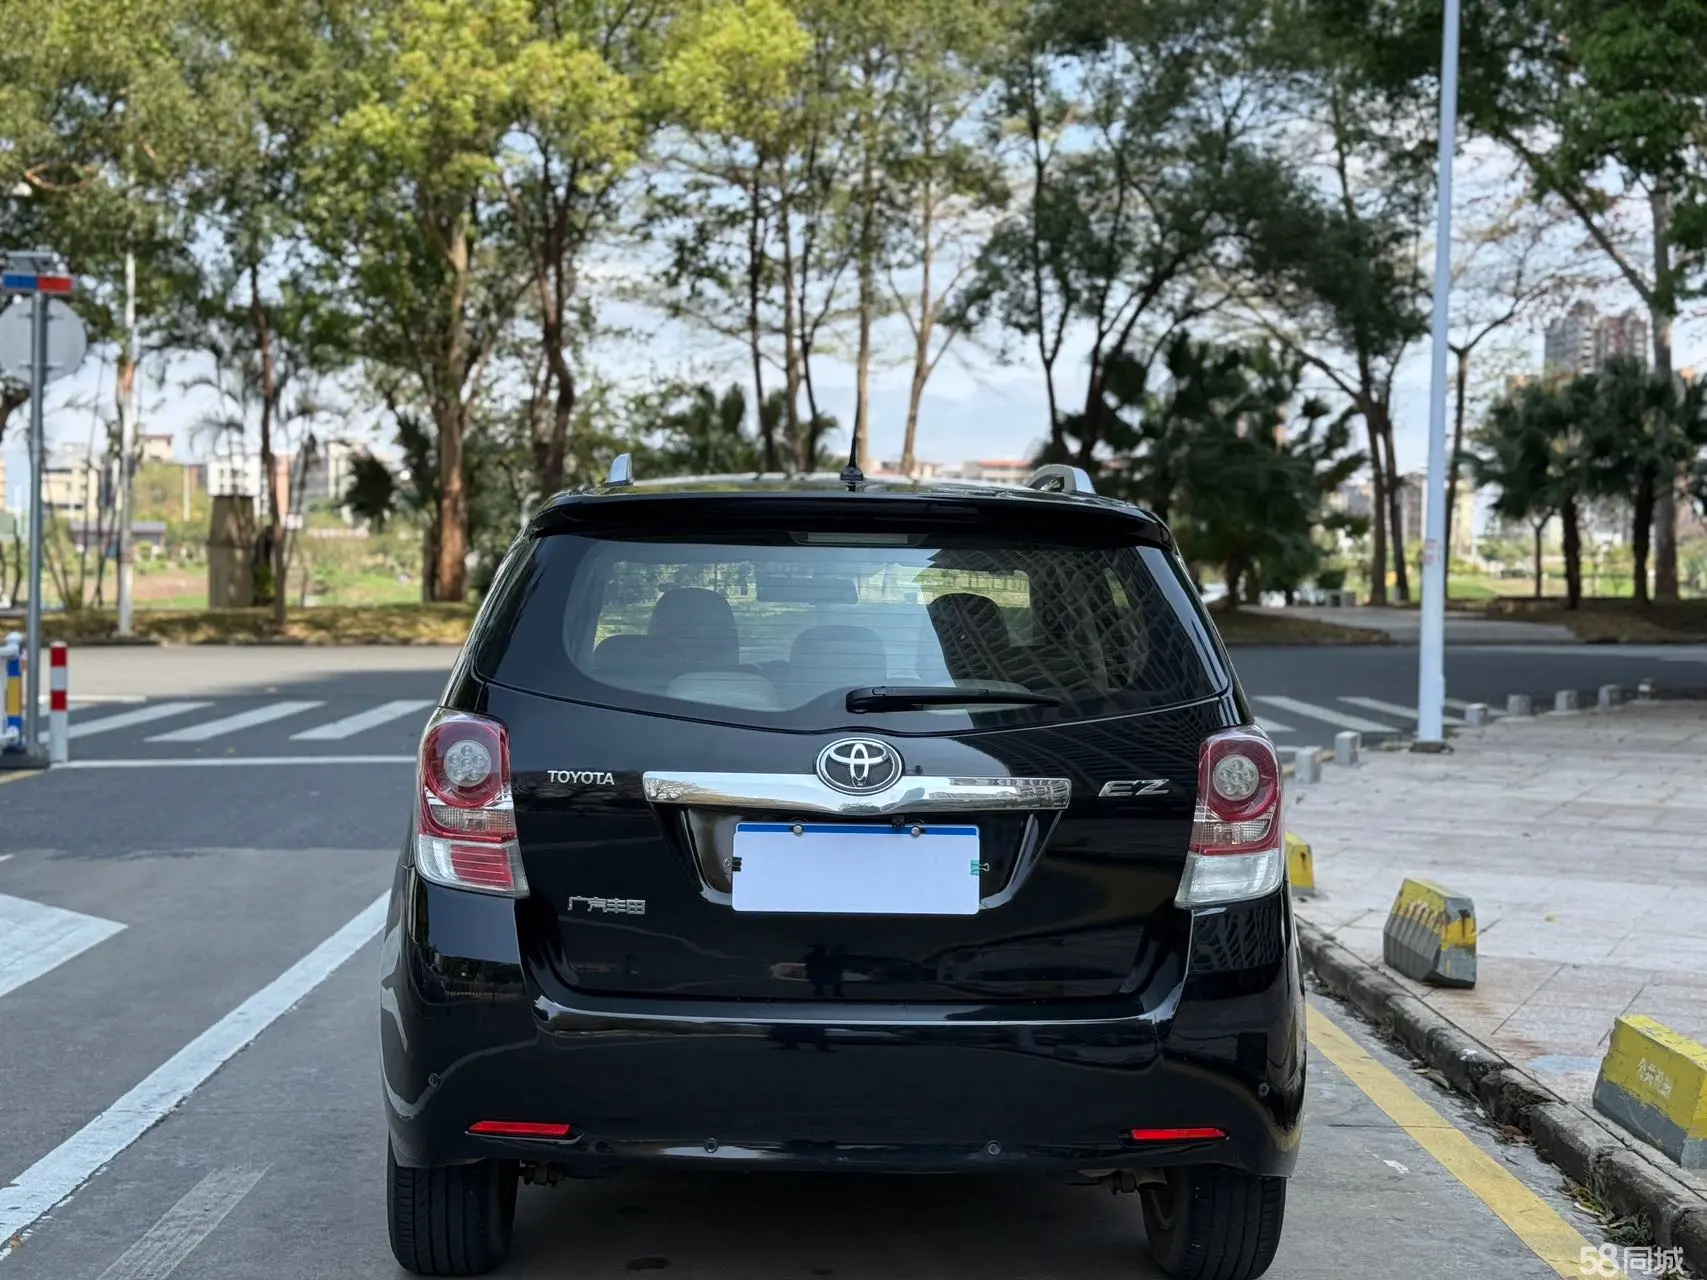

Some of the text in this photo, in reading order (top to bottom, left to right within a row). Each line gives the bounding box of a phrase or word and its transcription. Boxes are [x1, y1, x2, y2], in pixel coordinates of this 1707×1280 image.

[547, 770, 615, 785] TOYOTA
[1098, 779, 1170, 797] EZ
[567, 895, 646, 915] 广汽丰田
